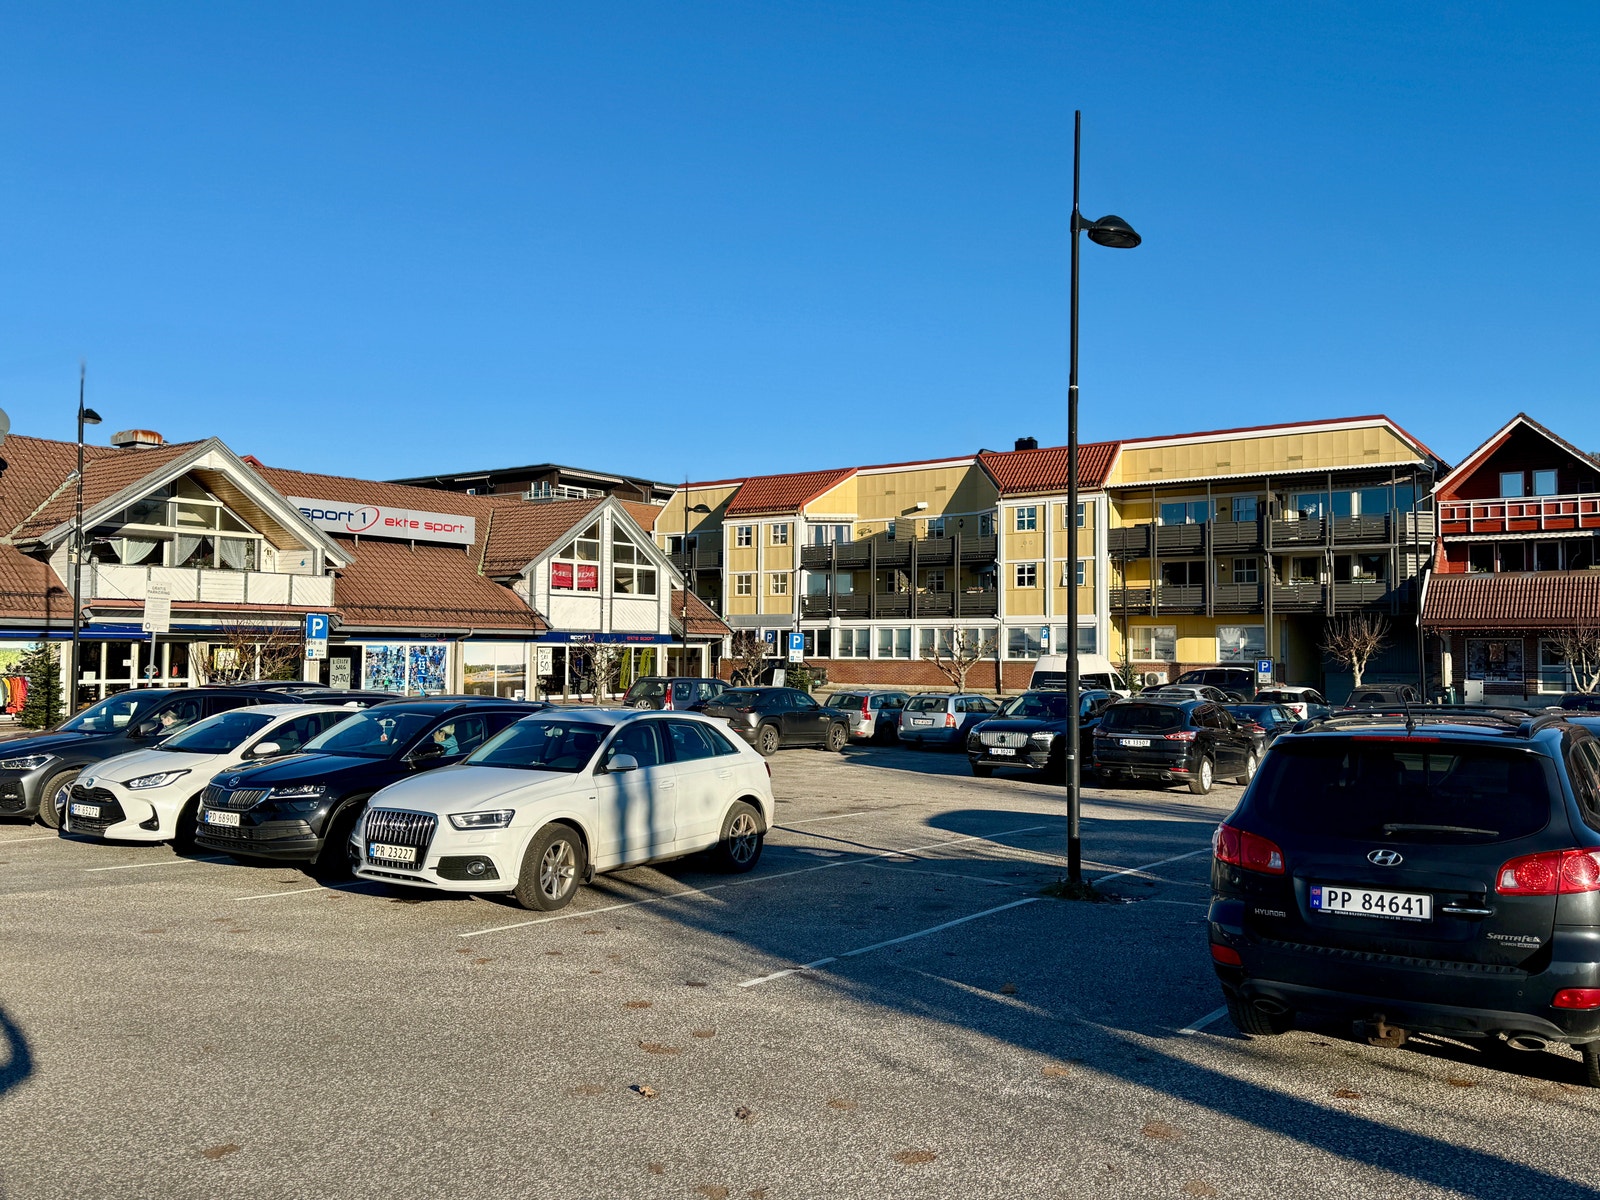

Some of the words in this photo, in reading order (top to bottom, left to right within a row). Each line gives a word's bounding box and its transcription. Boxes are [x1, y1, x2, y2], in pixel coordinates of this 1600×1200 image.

[298, 507, 354, 522] sport
[361, 512, 366, 524] 1
[384, 517, 419, 529] ekte
[424, 521, 464, 534] sport
[312, 618, 323, 637] P
[793, 635, 801, 648] P
[1261, 661, 1269, 671] P
[209, 811, 216, 821] PD
[218, 813, 238, 824] 68900
[375, 845, 385, 856] PR
[388, 847, 414, 859] 23227
[1327, 890, 1352, 908] PP
[1361, 893, 1423, 916] 84641
[1254, 908, 1286, 918] HYUNDAI
